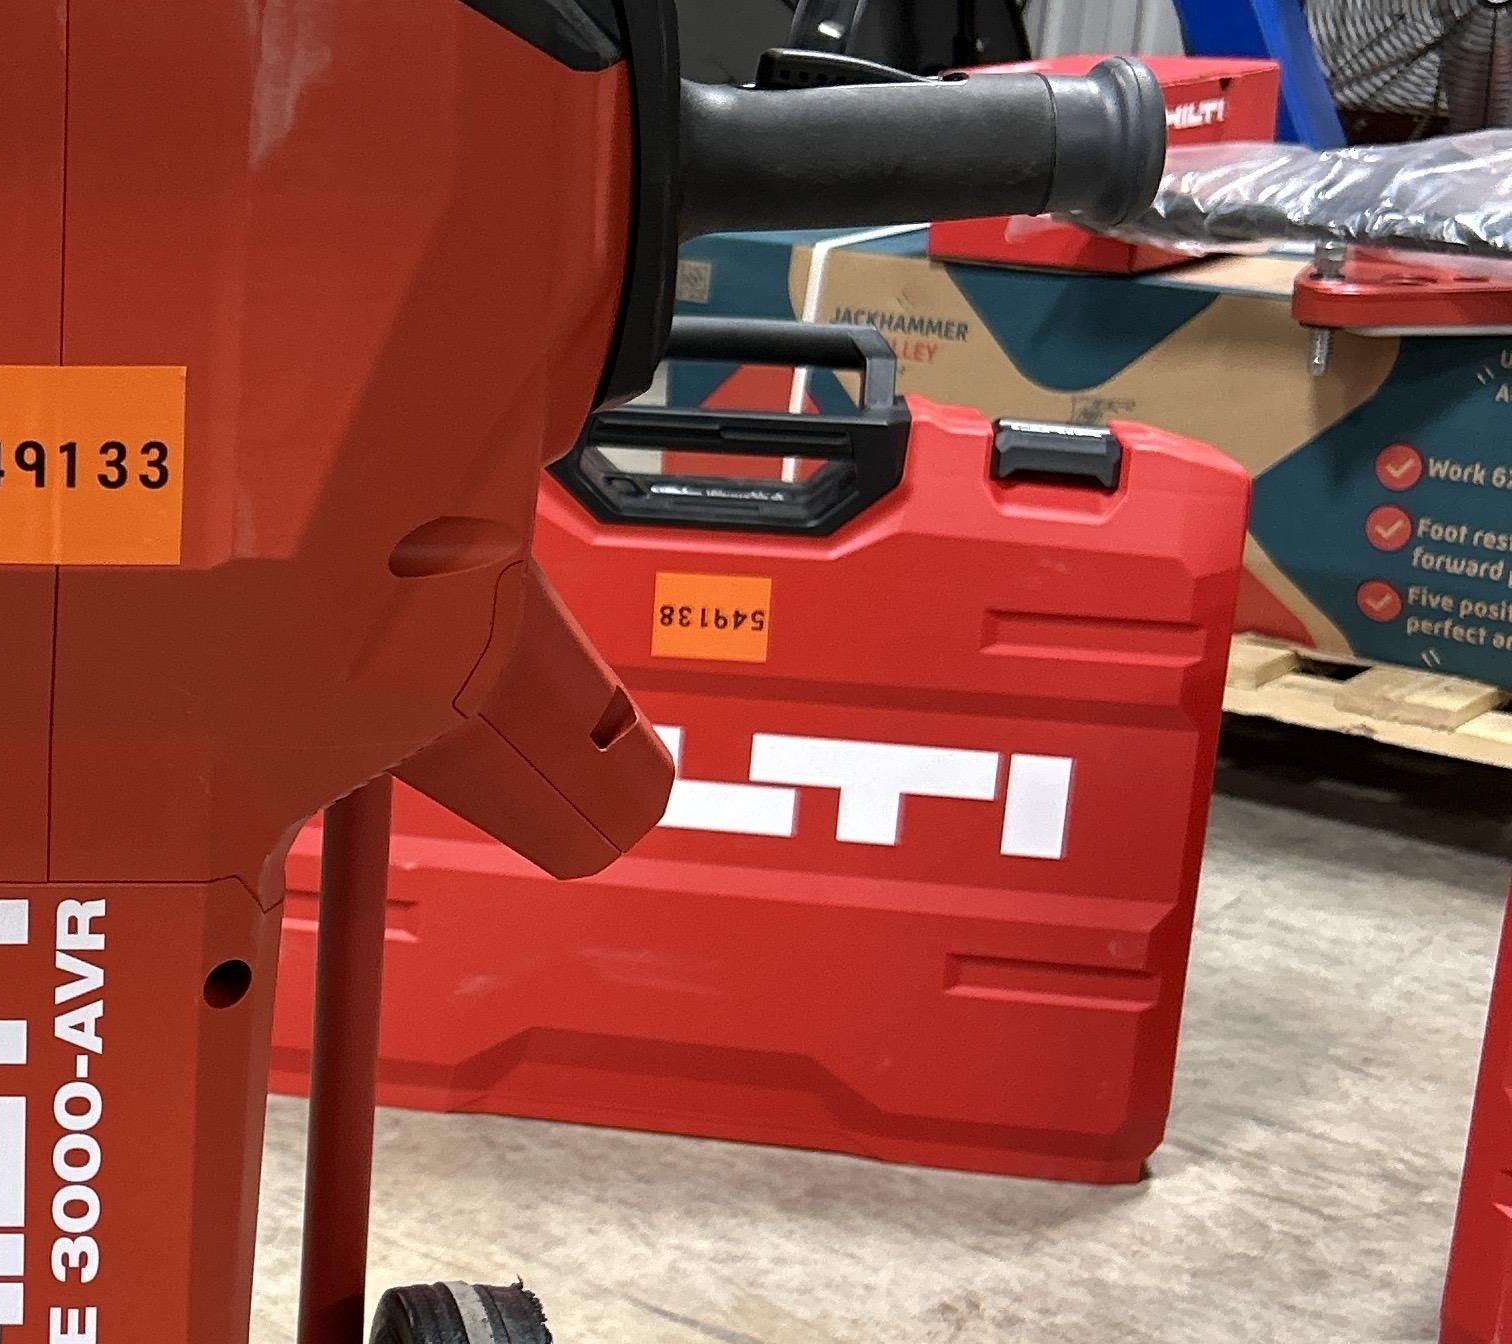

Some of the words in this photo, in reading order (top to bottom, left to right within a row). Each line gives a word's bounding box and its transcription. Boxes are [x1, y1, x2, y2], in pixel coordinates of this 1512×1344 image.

[831, 307, 969, 343] JACKHAMMER
[1427, 457, 1487, 486] Work
[1416, 517, 1468, 545] Foot
[1411, 545, 1505, 582] forward
[1407, 585, 1454, 613] Five
[659, 605, 765, 632] 549138
[1406, 615, 1487, 646] perfect
[652, 725, 1073, 860] LTI
[51, 898, 106, 1284] 3000-AVR
